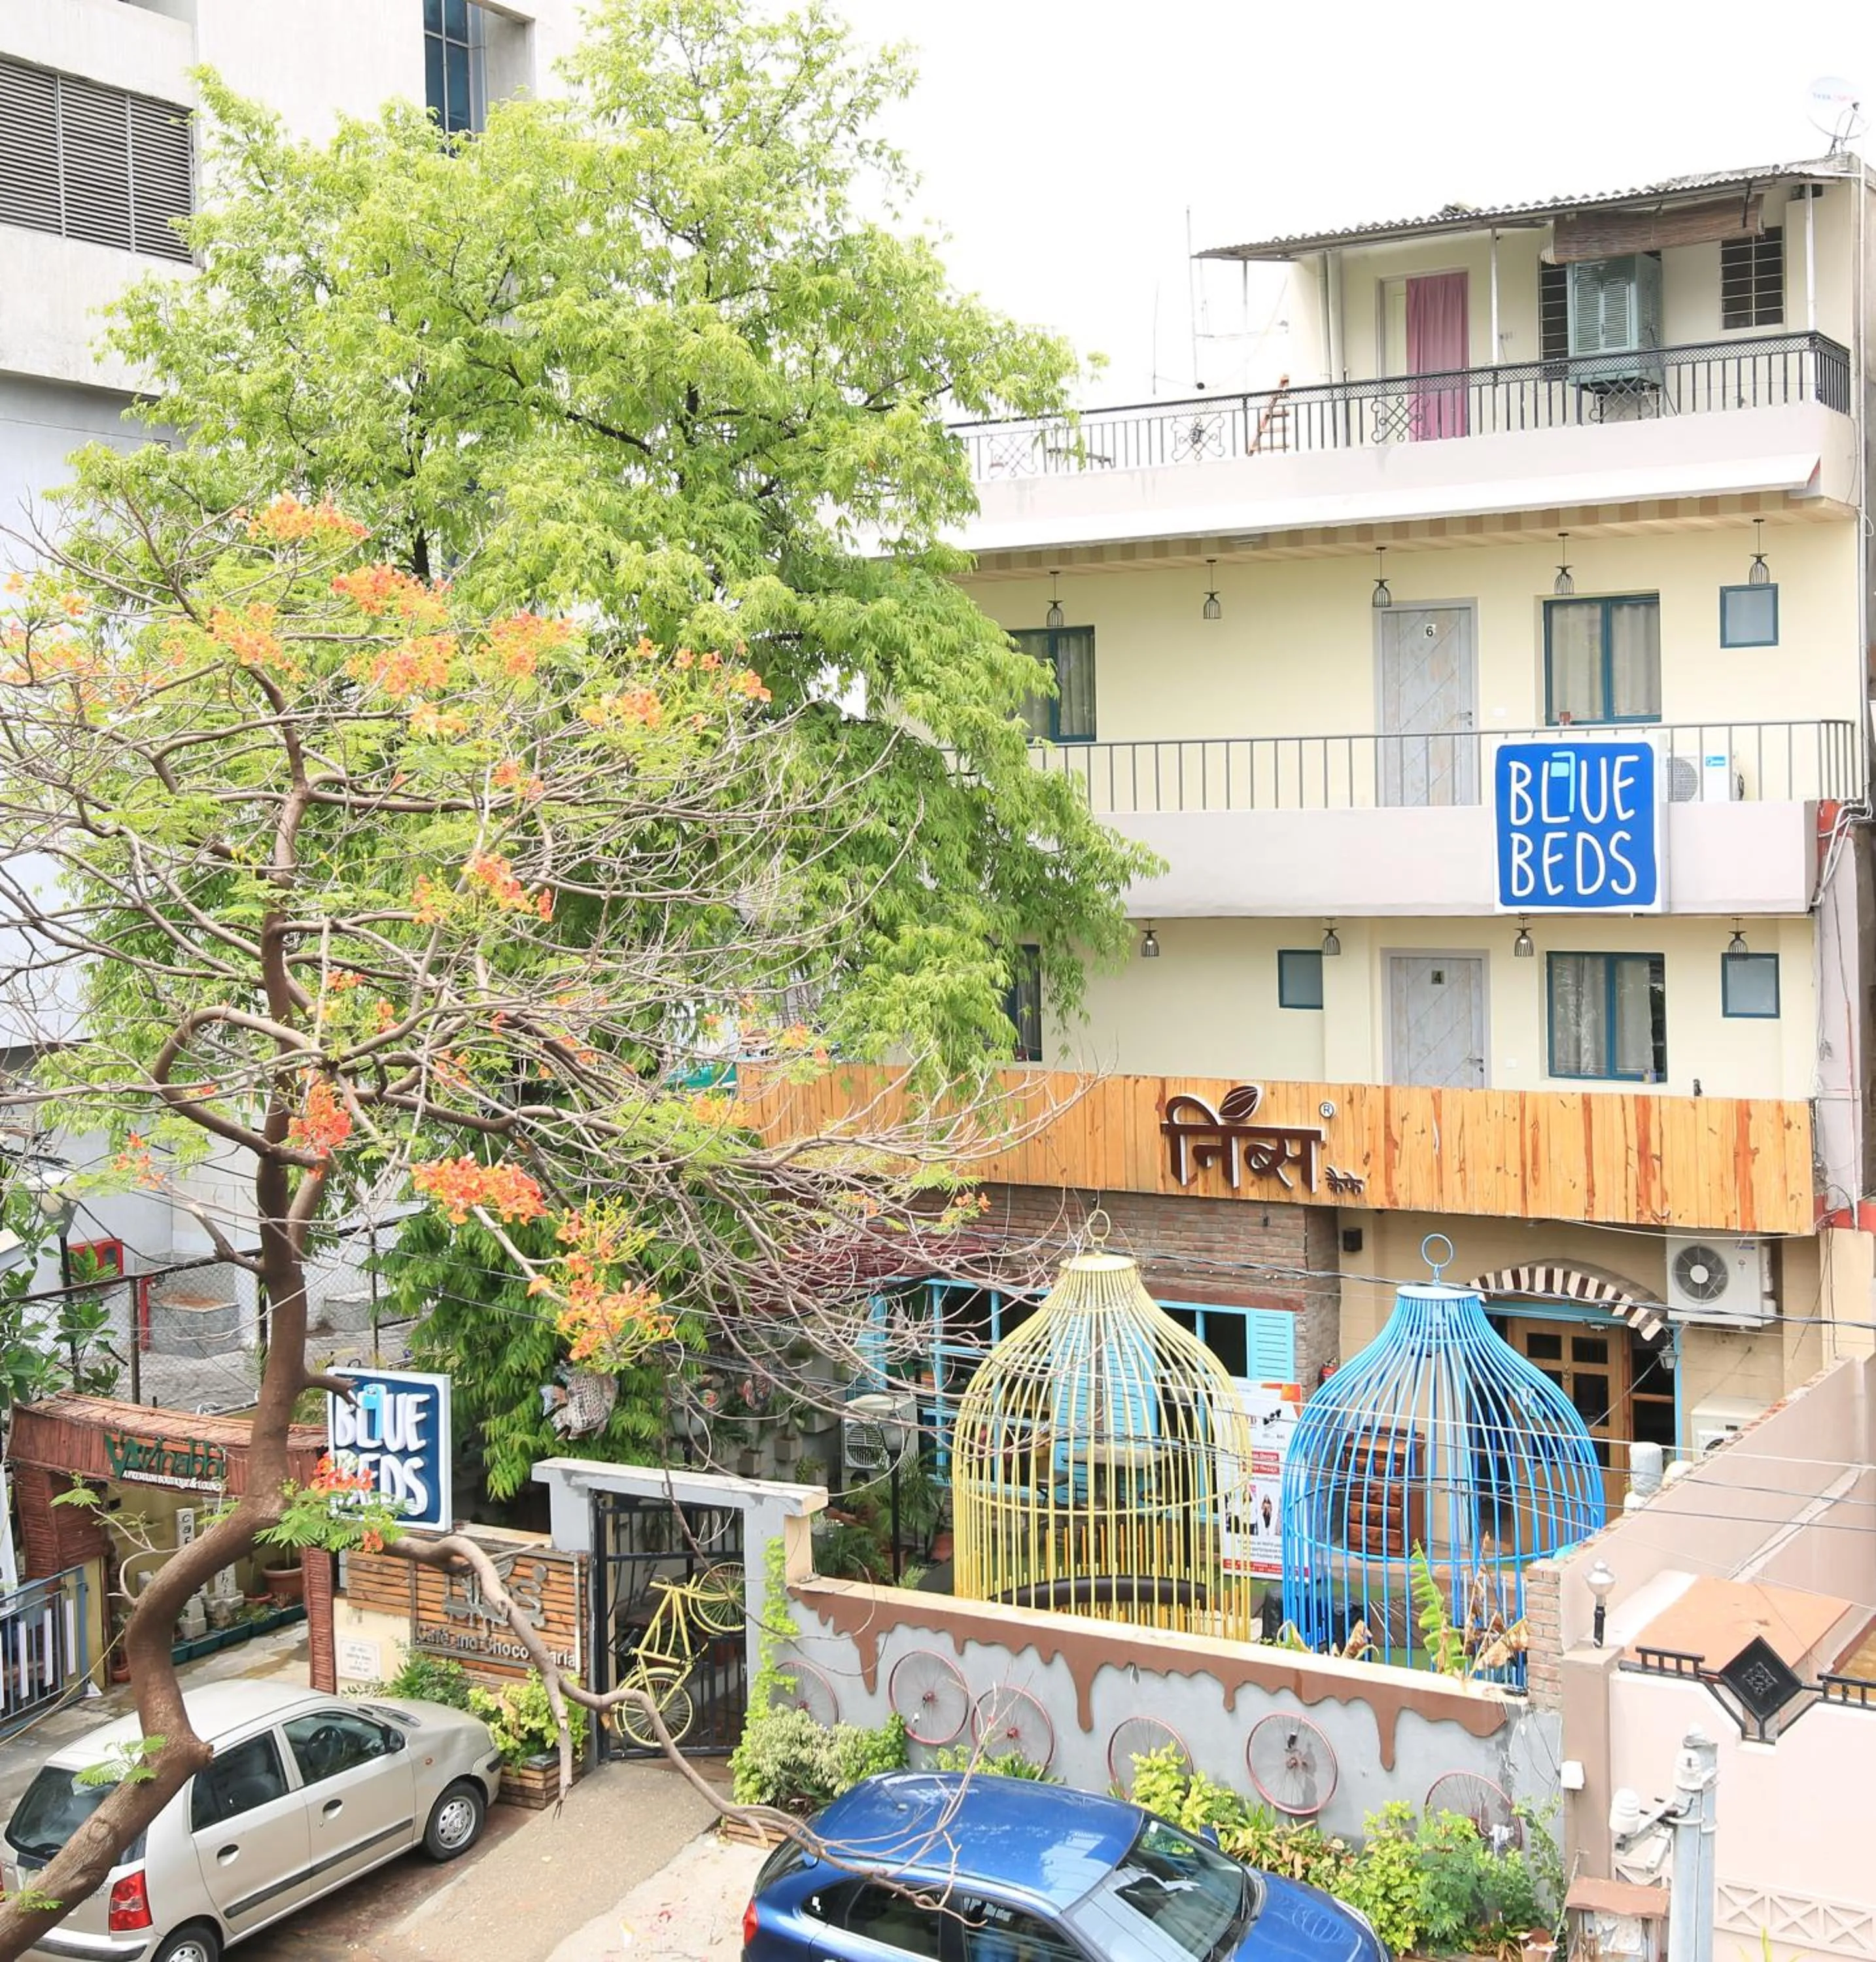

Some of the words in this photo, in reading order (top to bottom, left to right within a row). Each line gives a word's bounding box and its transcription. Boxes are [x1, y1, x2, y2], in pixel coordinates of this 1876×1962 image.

[1425, 625, 1434, 637] 6
[1508, 751, 1640, 826] BLUE
[1510, 831, 1637, 897] BEDS
[1433, 971, 1442, 984] 4
[335, 1384, 431, 1453] BLUE
